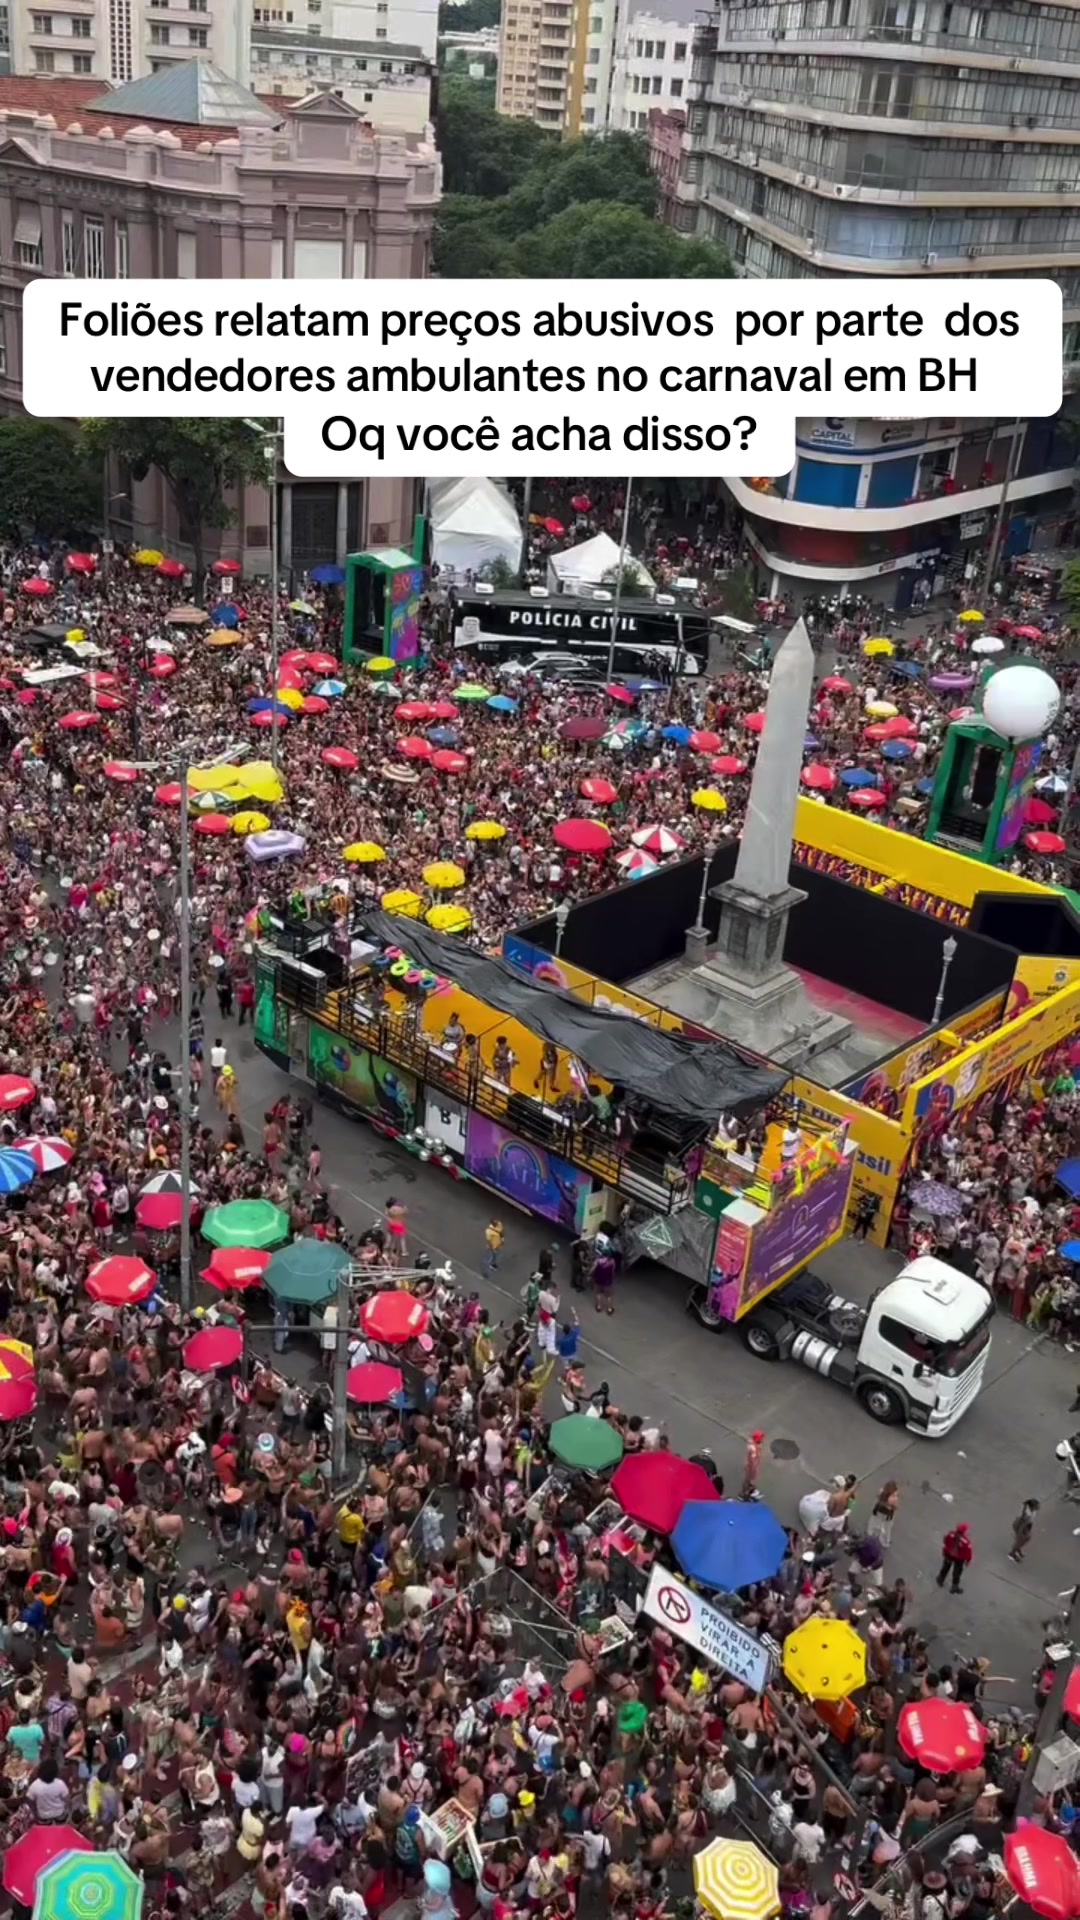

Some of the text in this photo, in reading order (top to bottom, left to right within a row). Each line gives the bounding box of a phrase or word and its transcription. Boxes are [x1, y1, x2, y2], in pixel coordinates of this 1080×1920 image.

[811, 429, 852, 441] CAPITAL
[509, 610, 638, 631] POLÍCIA CIVIL
[857, 1149, 891, 1176] asil
[701, 1607, 760, 1659] PROIBIDO
[701, 1622, 739, 1657] VIRAR
[700, 1636, 748, 1679] DIREITA
